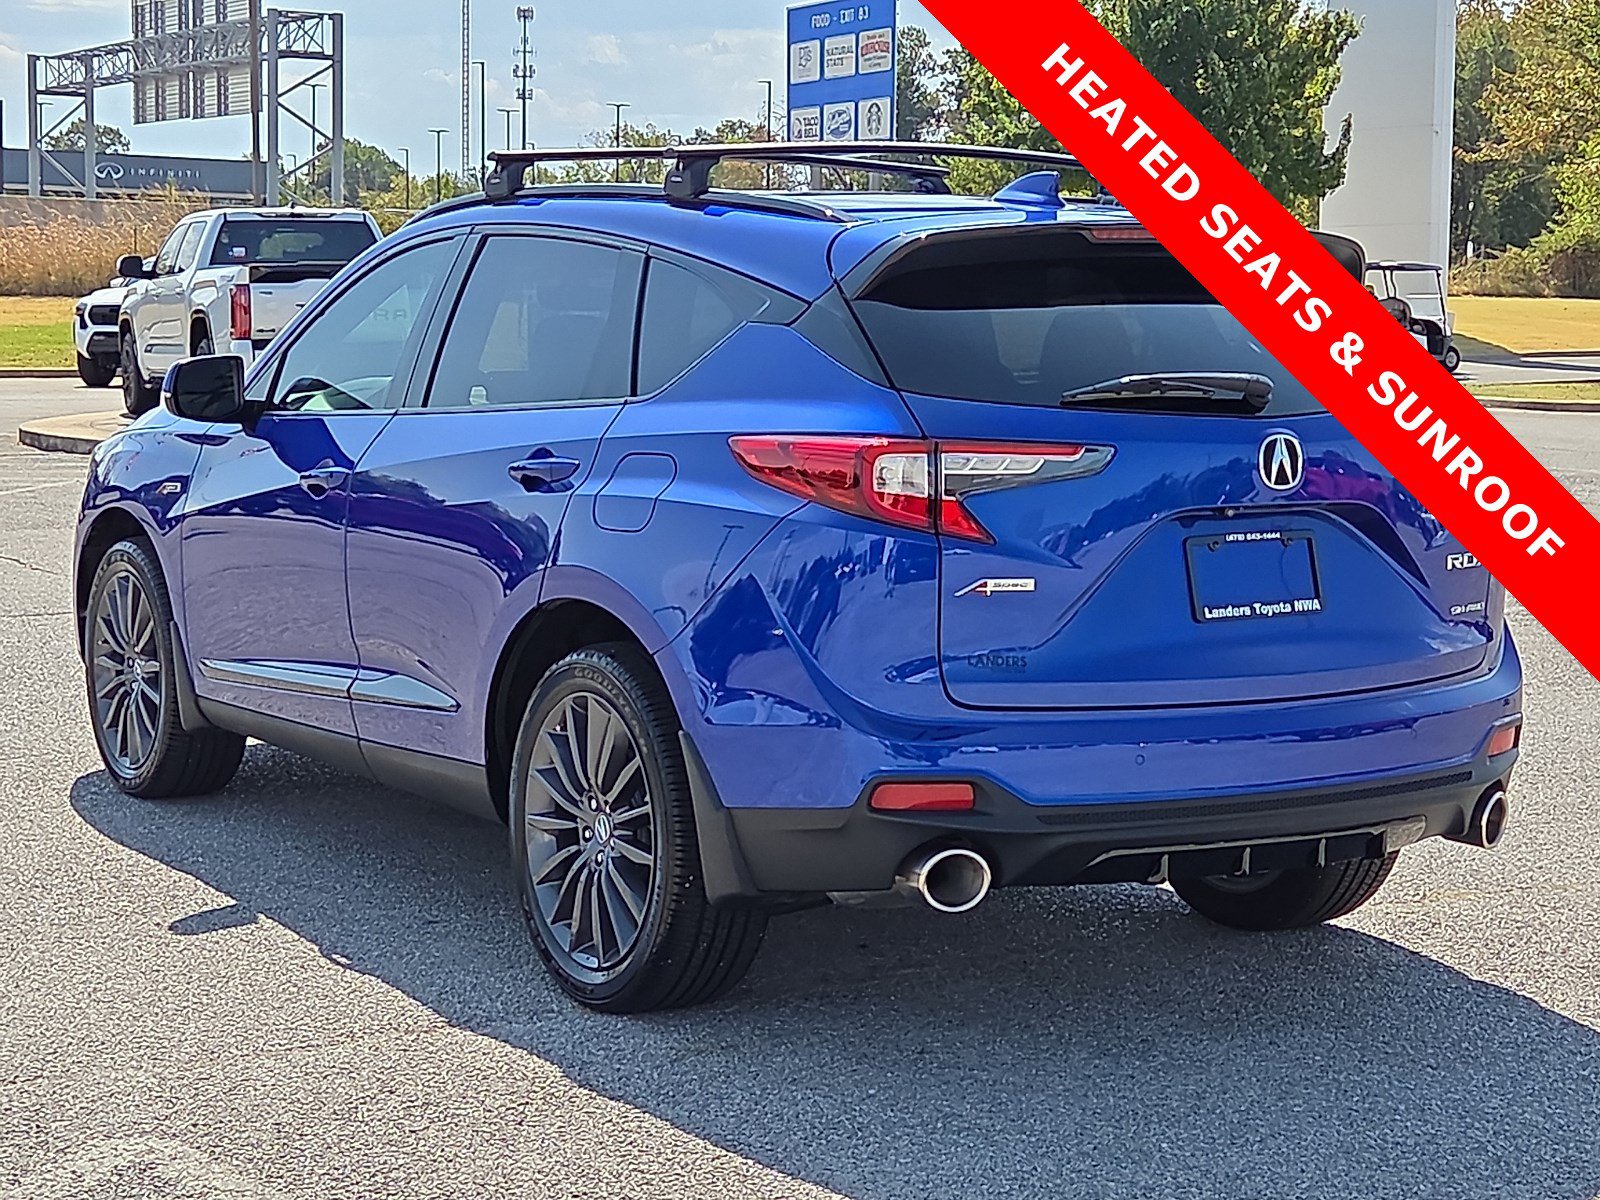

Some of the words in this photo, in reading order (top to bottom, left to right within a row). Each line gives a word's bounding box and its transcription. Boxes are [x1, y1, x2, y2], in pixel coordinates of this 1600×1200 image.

[811, 13, 831, 29] FOOD
[840, 8, 855, 24] EXIT
[803, 116, 819, 127] TACO
[804, 127, 819, 138] BELL
[130, 167, 200, 178] INFINITI
[1446, 552, 1482, 570] RD
[1204, 605, 1251, 619] Landers
[1253, 602, 1291, 616] Toyota
[1294, 599, 1321, 611] NWA
[967, 654, 1028, 668] LANDERS
